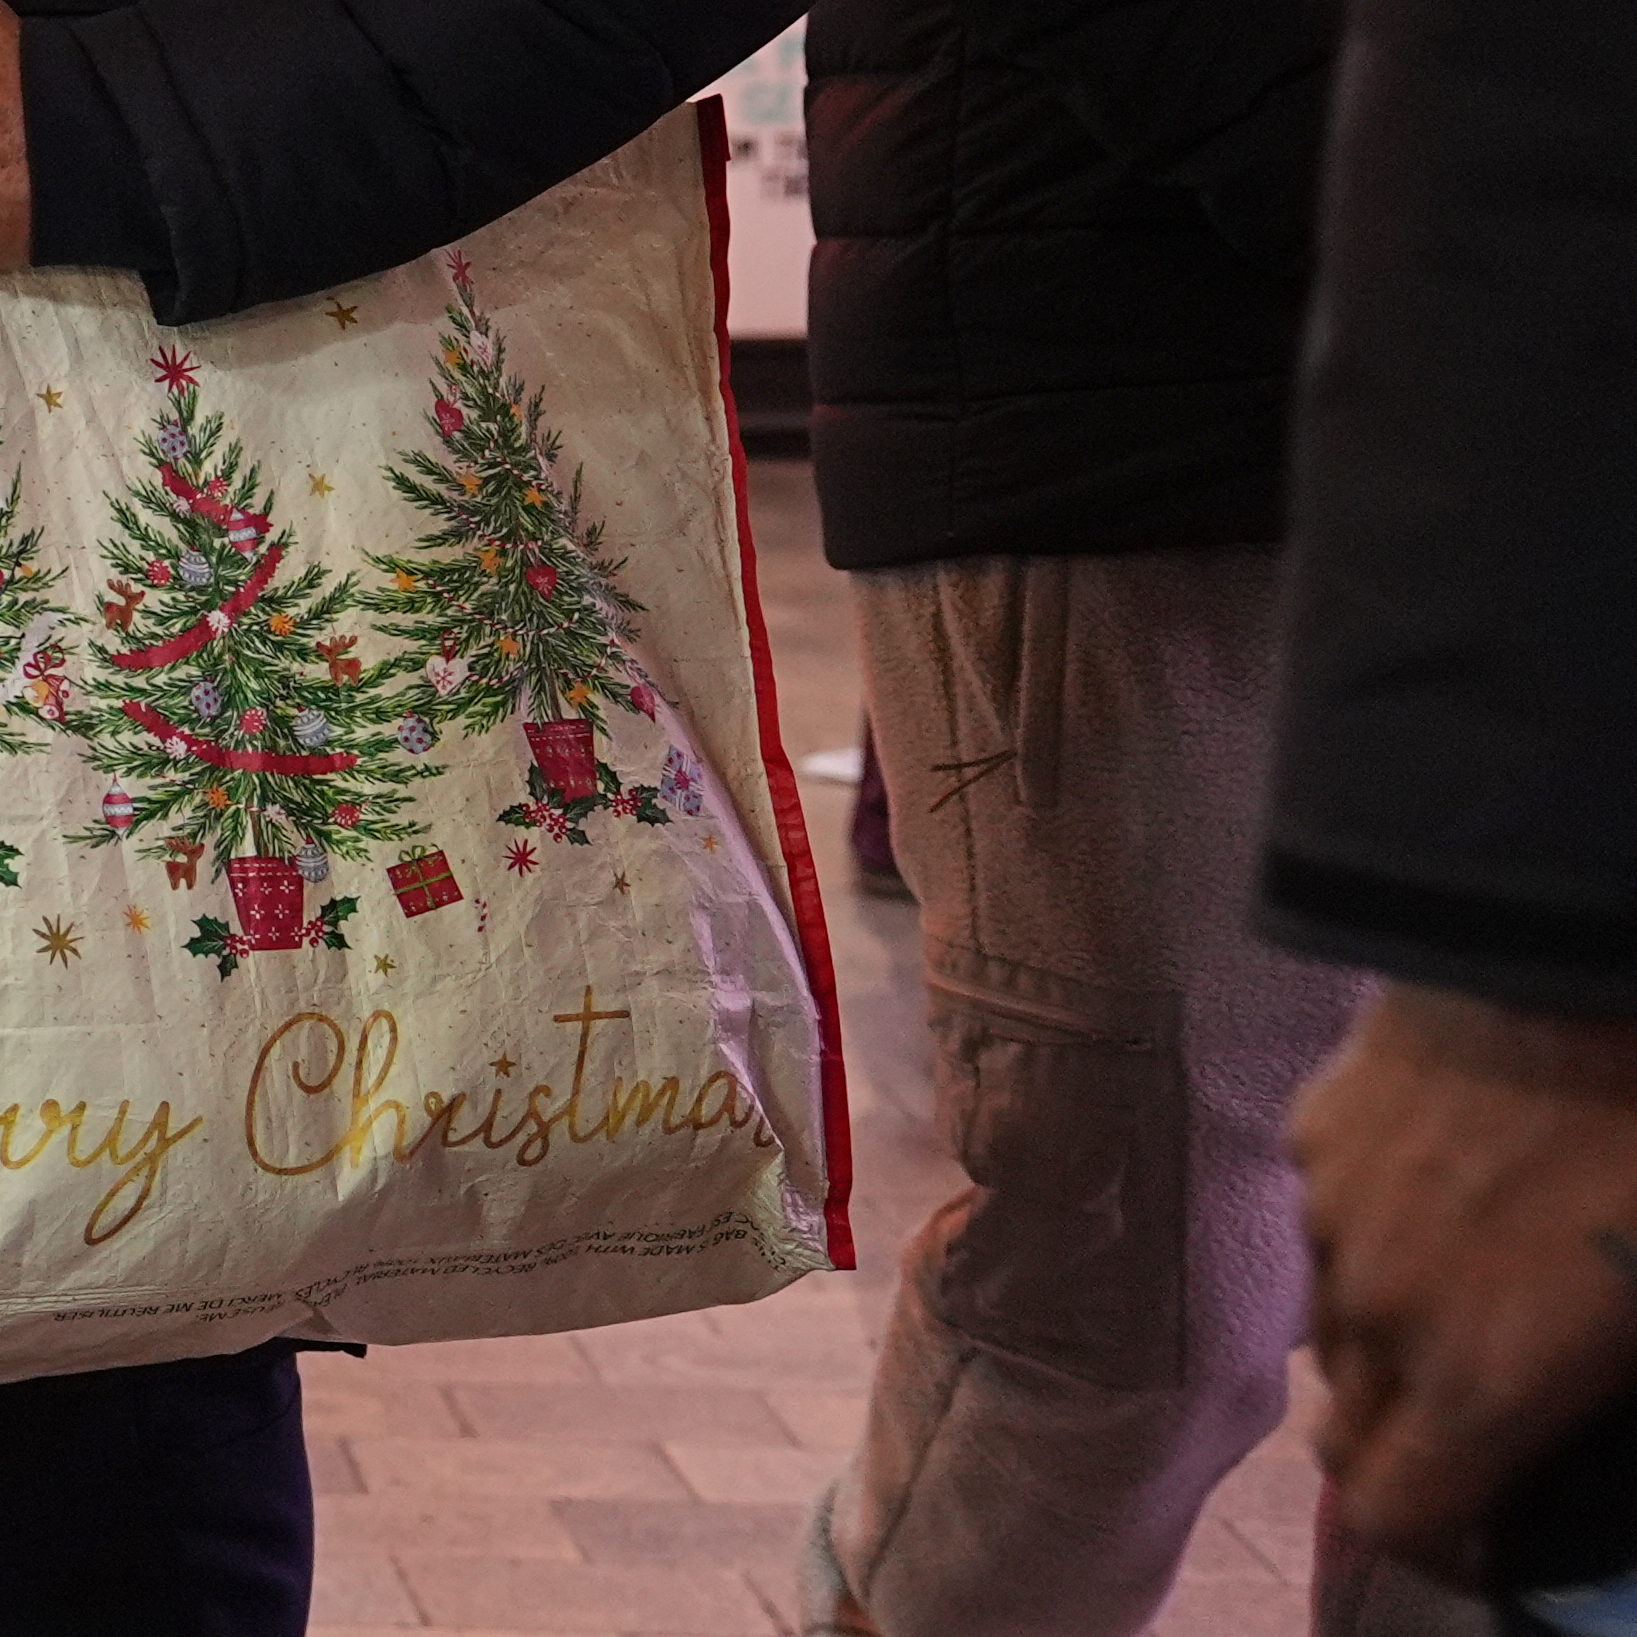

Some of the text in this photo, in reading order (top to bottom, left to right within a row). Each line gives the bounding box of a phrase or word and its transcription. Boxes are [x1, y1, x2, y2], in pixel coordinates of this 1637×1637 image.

[585, 1243, 636, 1256] WITH
[637, 1243, 696, 1258] MADE
[445, 1261, 538, 1277] RECYCLED
[195, 1299, 224, 1312] DE
[226, 1292, 286, 1308] MERCI
[164, 1301, 195, 1316] ME
